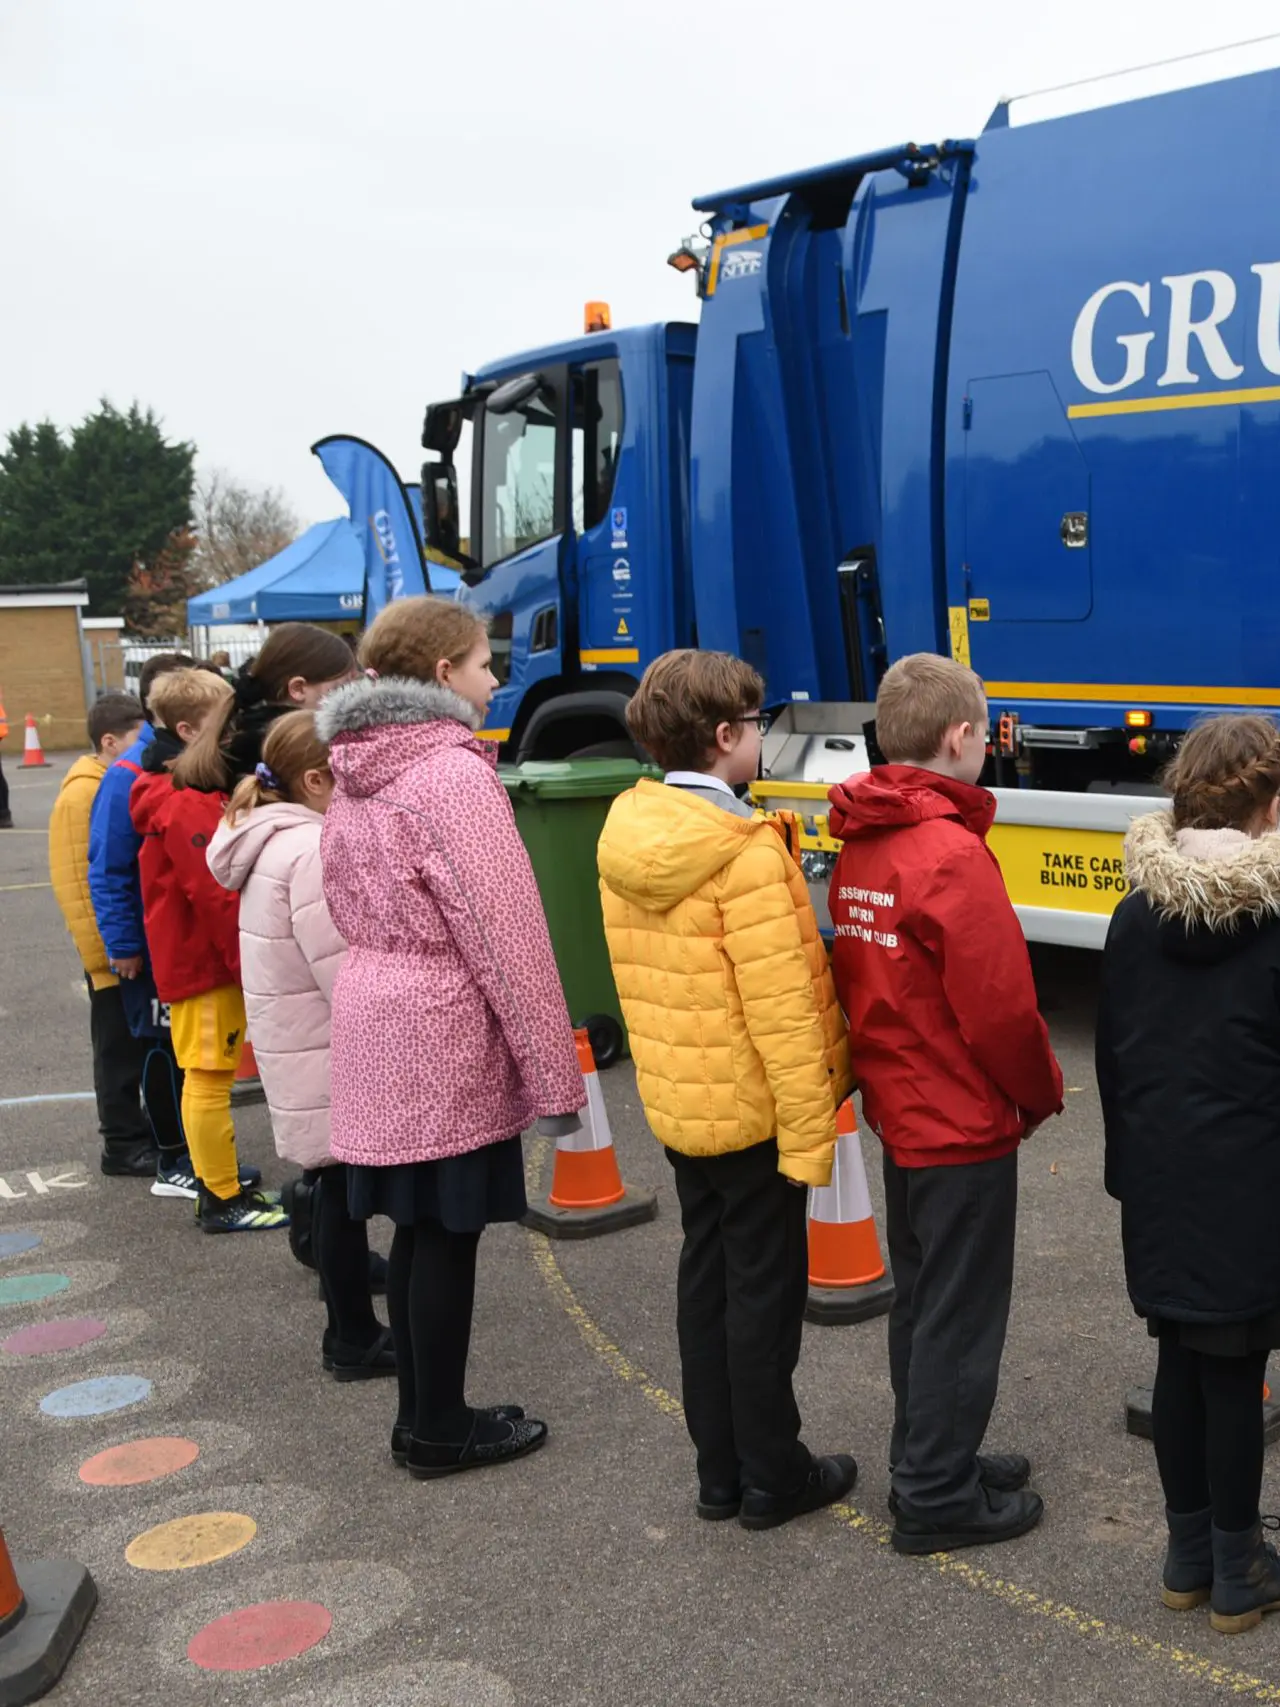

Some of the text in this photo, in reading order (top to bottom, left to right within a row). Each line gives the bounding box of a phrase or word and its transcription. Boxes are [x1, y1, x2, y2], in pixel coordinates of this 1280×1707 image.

[1042, 852, 1124, 873] TAKE CAR
[1041, 870, 1127, 892] BLIND SPO
